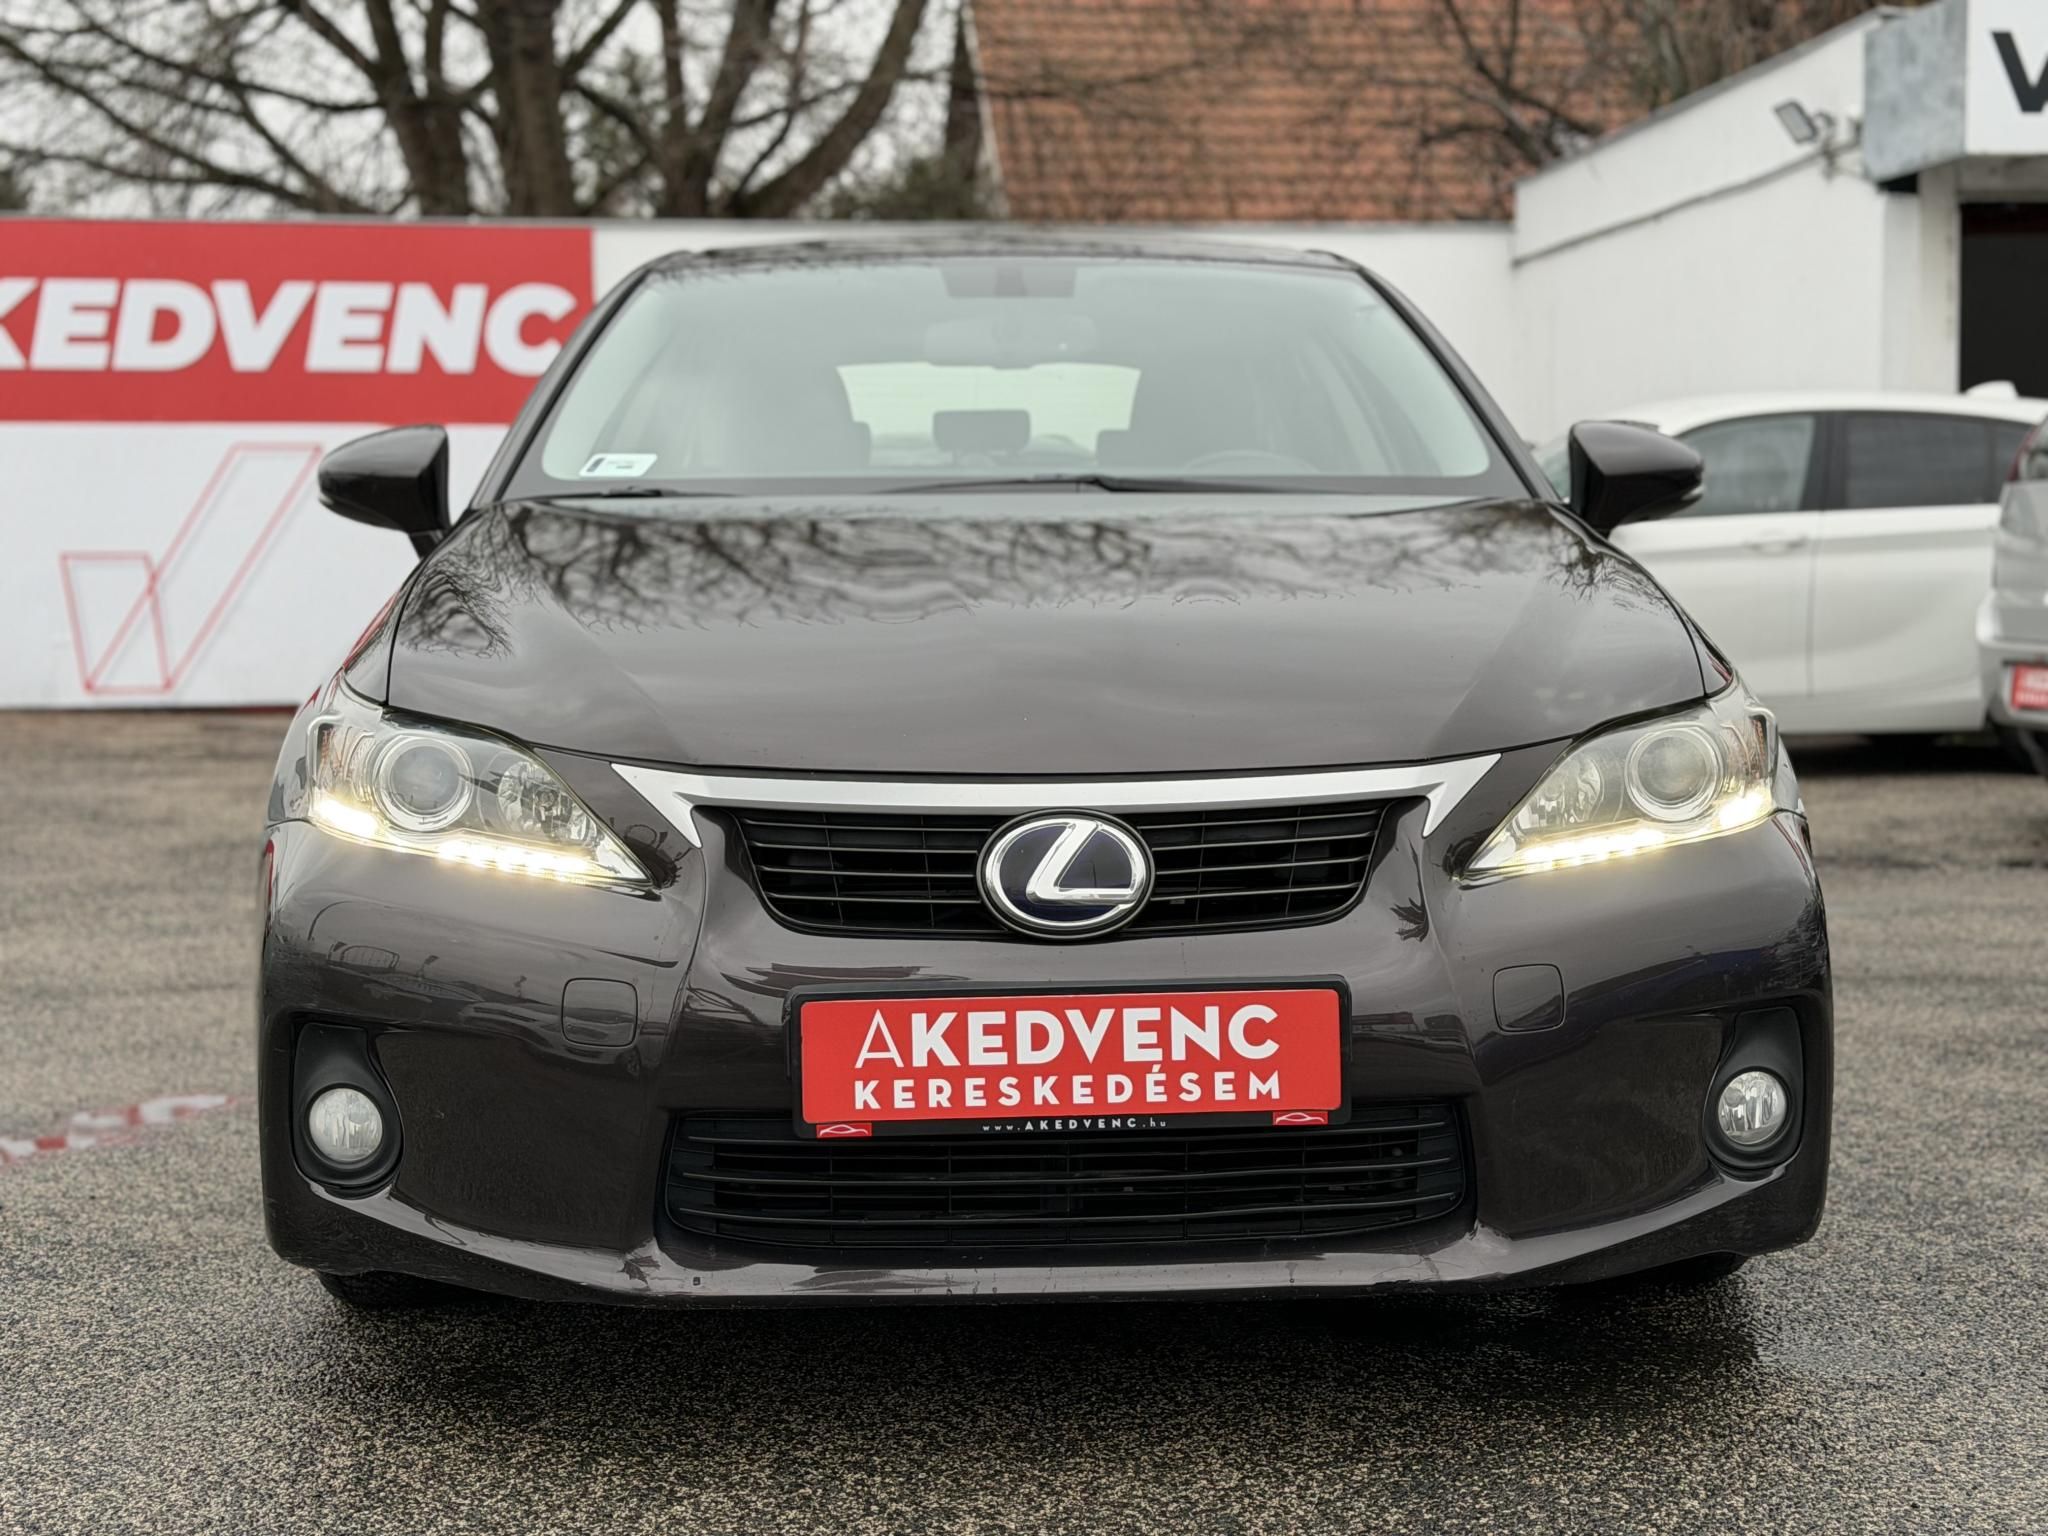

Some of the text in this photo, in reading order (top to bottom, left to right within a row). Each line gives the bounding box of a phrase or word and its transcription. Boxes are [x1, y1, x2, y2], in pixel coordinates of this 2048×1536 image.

[854, 1004, 1280, 1068] AKEDVENC
[854, 1064, 1281, 1110] KERESKEDÉSEM
[982, 1117, 1168, 1132] www.AKEDVENC.hu
